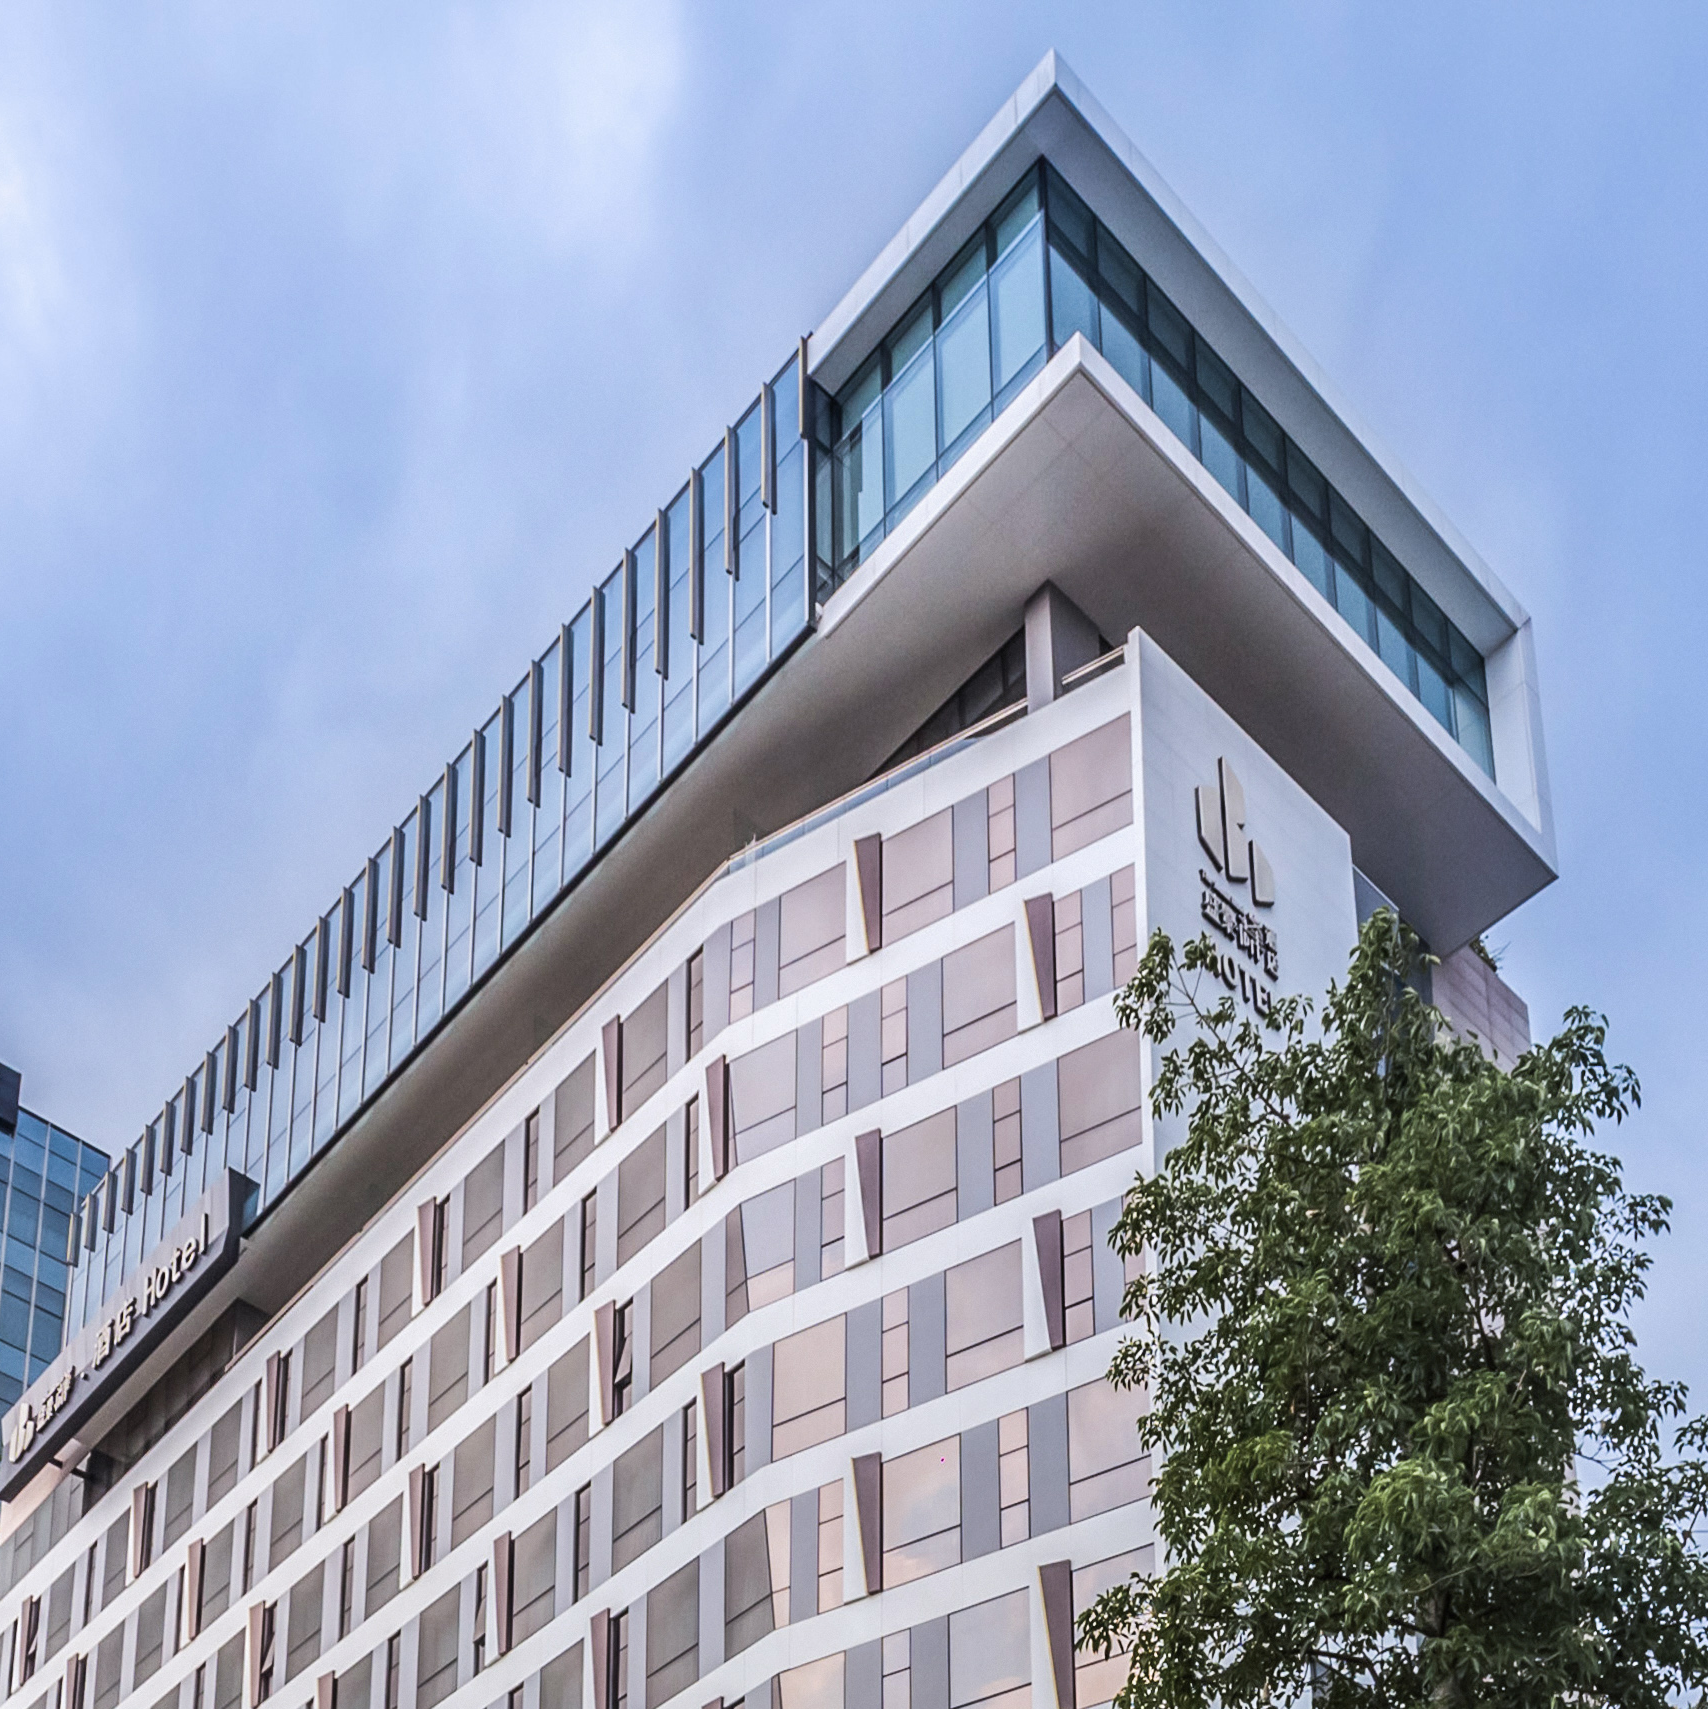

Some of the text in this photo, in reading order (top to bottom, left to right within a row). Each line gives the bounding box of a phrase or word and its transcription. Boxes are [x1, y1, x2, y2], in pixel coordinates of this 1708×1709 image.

[1209, 948, 1274, 1020] OTE
[91, 1212, 210, 1369] 酒店 Hotel
